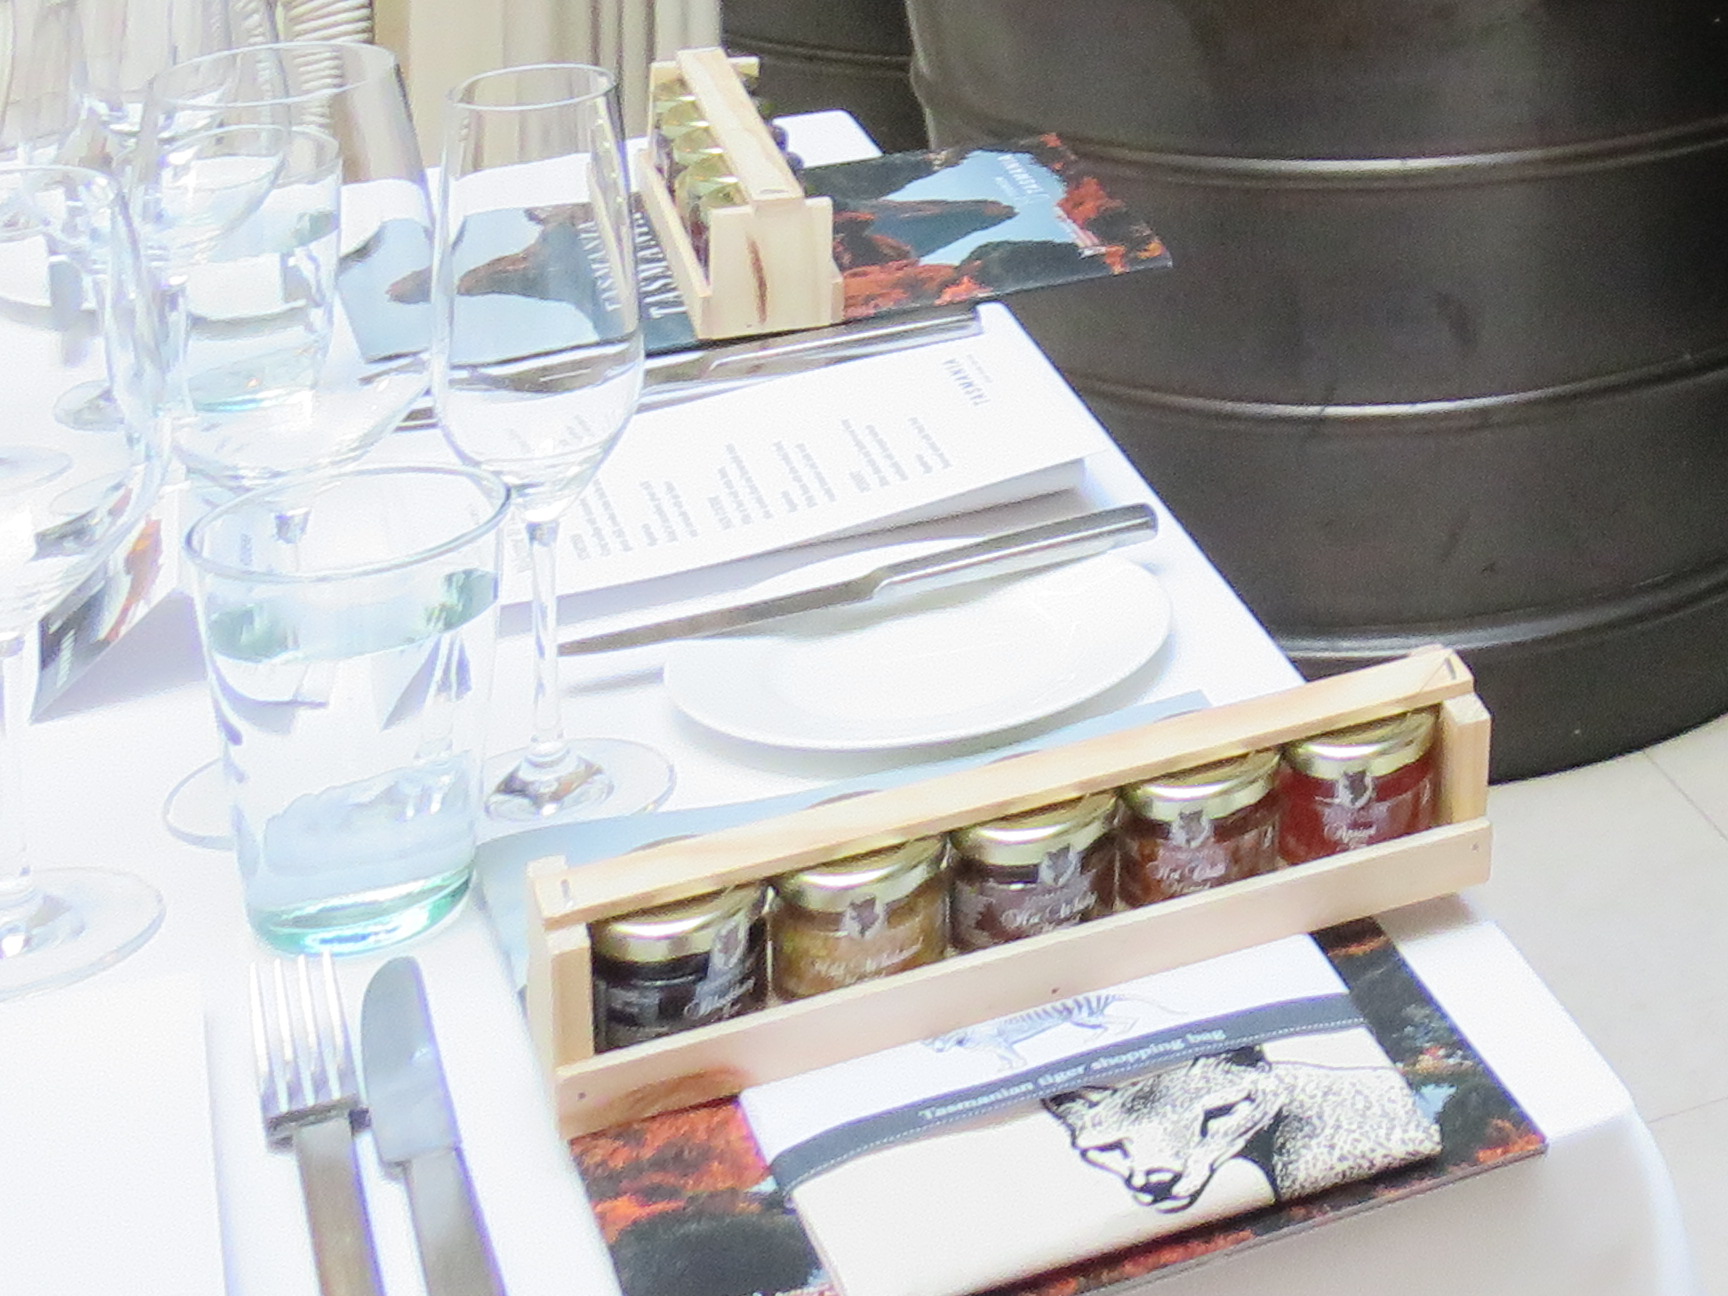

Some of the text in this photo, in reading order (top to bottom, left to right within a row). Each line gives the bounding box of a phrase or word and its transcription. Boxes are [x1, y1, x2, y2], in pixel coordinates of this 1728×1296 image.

[941, 358, 989, 407] TASMANIA
[918, 1029, 1226, 1120] Tasmanian tiger shopping bag
